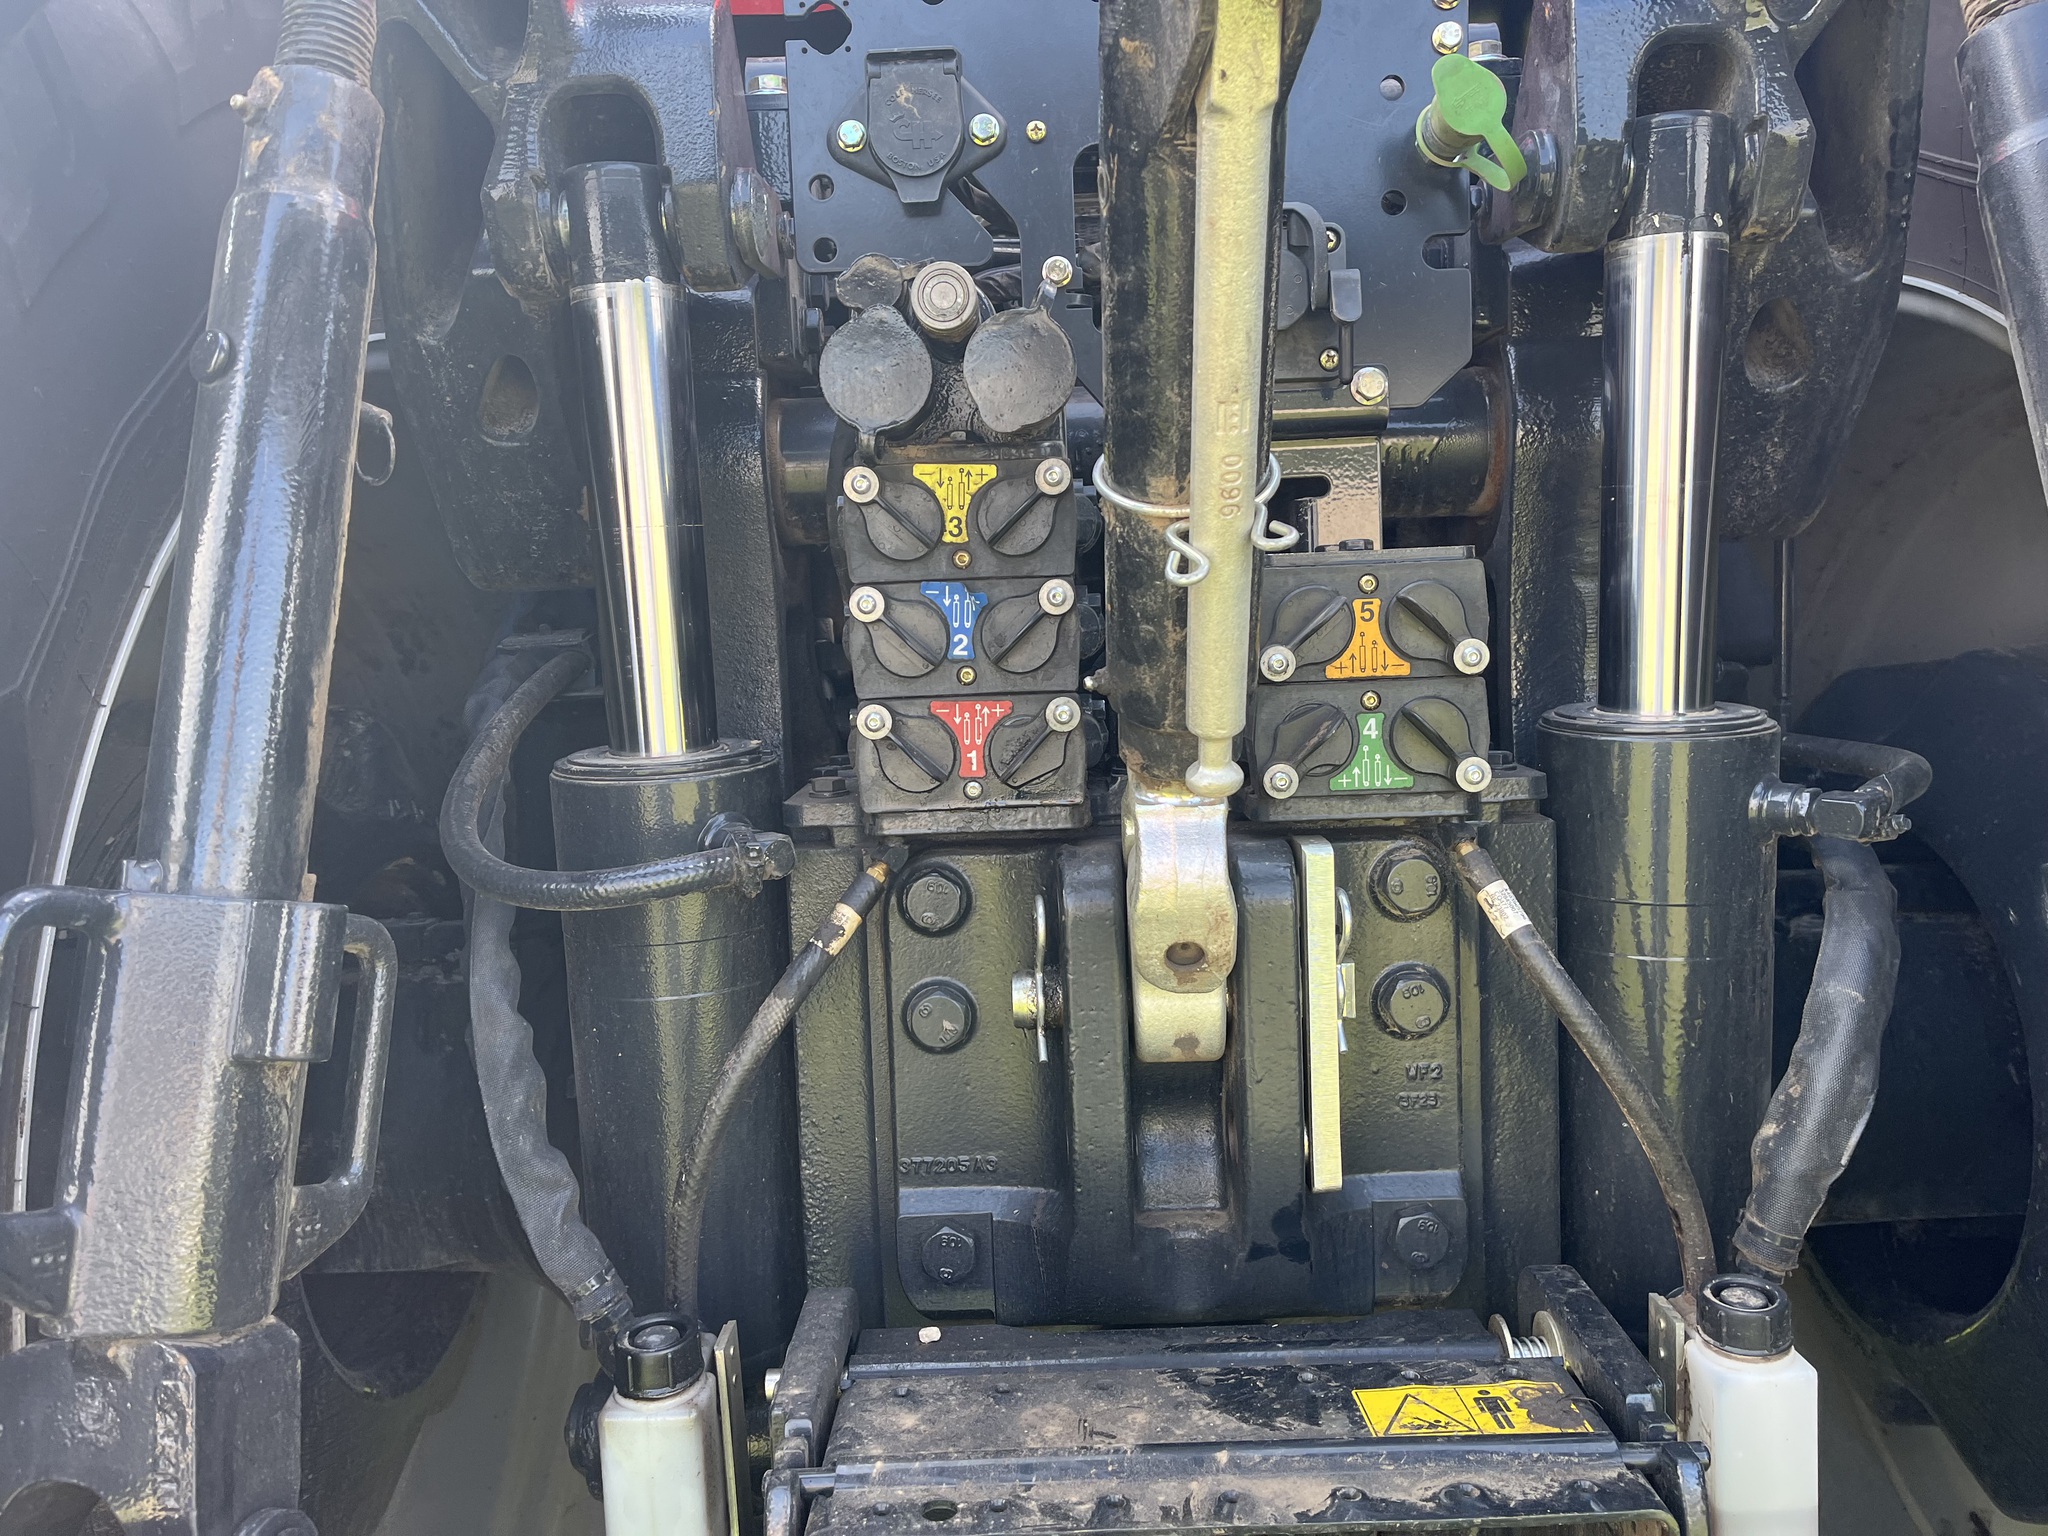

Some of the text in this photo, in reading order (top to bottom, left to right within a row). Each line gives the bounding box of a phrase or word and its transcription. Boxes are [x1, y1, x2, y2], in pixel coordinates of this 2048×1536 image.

[887, 151, 922, 171] BOSTON
[1218, 454, 1244, 519] 9600
[948, 516, 963, 538] 3
[1359, 601, 1375, 623] 5
[952, 633, 969, 656] 2
[1362, 717, 1379, 740] 4
[966, 750, 979, 771] 1
